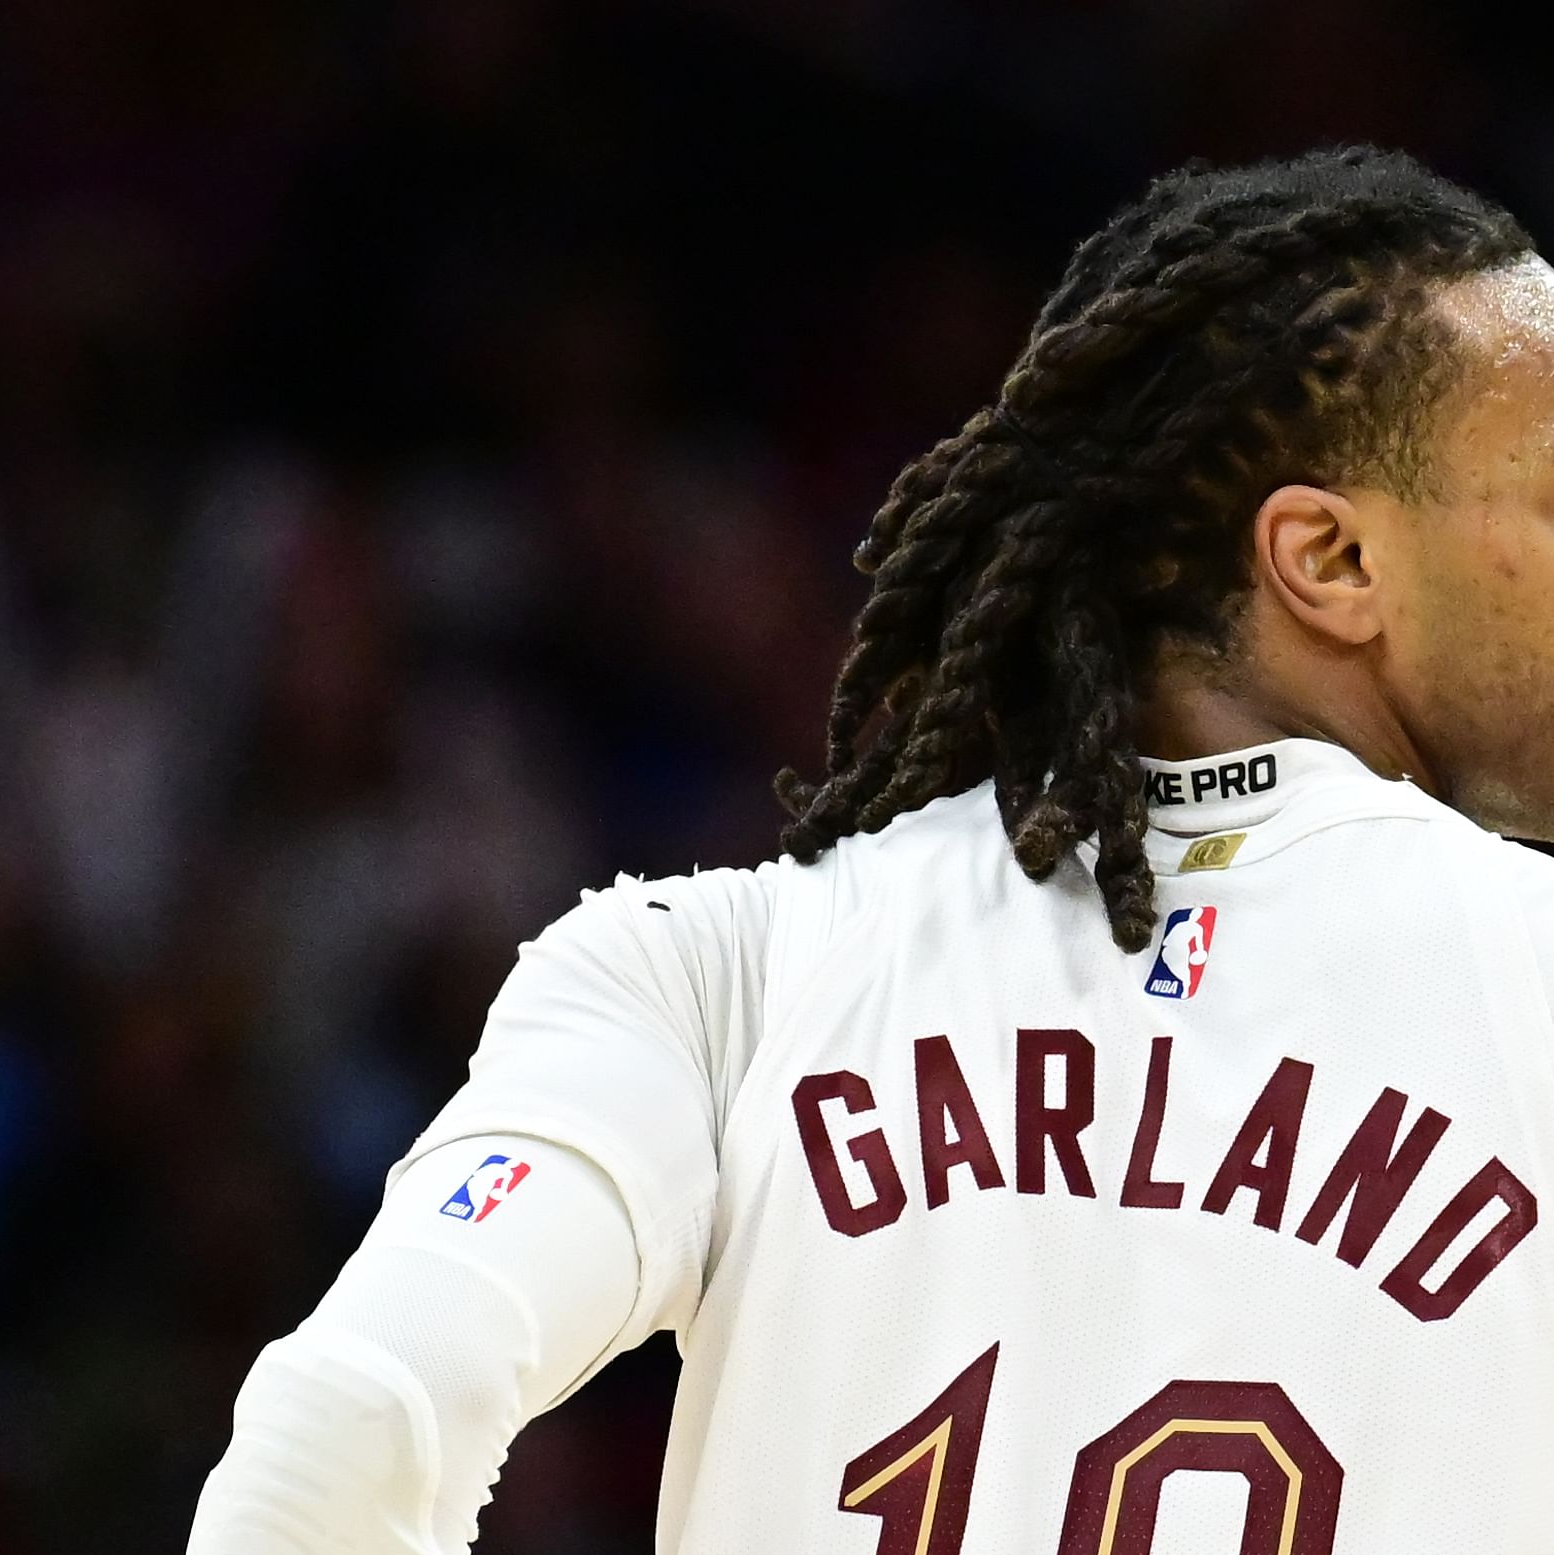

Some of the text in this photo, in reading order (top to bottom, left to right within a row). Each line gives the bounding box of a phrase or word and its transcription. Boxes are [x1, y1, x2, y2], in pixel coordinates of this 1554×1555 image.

[1145, 754, 1277, 805] KE PRO
[1150, 979, 1179, 994] NBA
[791, 1028, 1539, 1323] GARLAND
[443, 1201, 472, 1217] NBA
